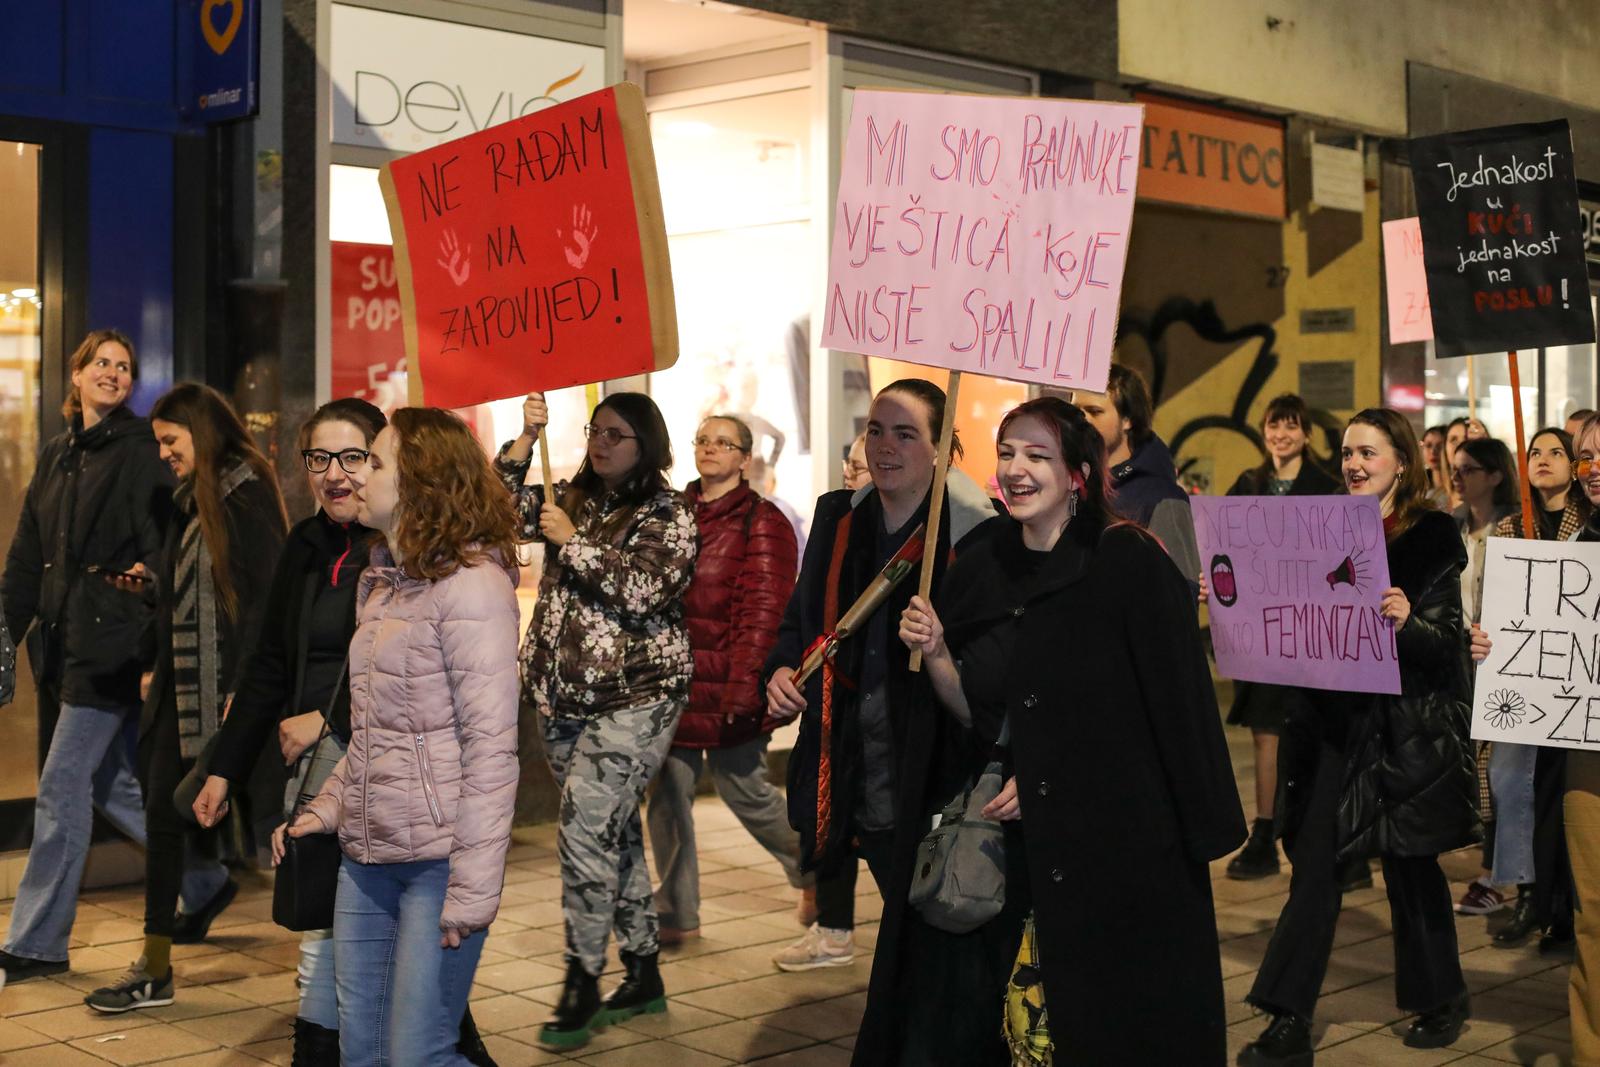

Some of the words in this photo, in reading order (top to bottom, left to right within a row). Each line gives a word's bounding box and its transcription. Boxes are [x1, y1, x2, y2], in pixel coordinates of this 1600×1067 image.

[418, 156, 462, 222] NE
[486, 107, 607, 193] RAĐAM
[867, 115, 908, 186] MI
[931, 124, 1000, 188] SMO
[1020, 114, 1136, 195] PRAUNUKE
[1437, 146, 1556, 201] Jednakost
[844, 194, 1011, 274] VJEŠTICA
[1468, 203, 1533, 235] KUĆI
[487, 225, 526, 271] NA
[1457, 231, 1560, 273] jednakost
[1488, 268, 1511, 283] na
[829, 283, 931, 353] NISTE
[950, 288, 1096, 380] SPALILI
[1201, 500, 1284, 550] NEĆU
[1295, 504, 1379, 552] NIKAD
[1263, 603, 1398, 662] FEMINIZAM
